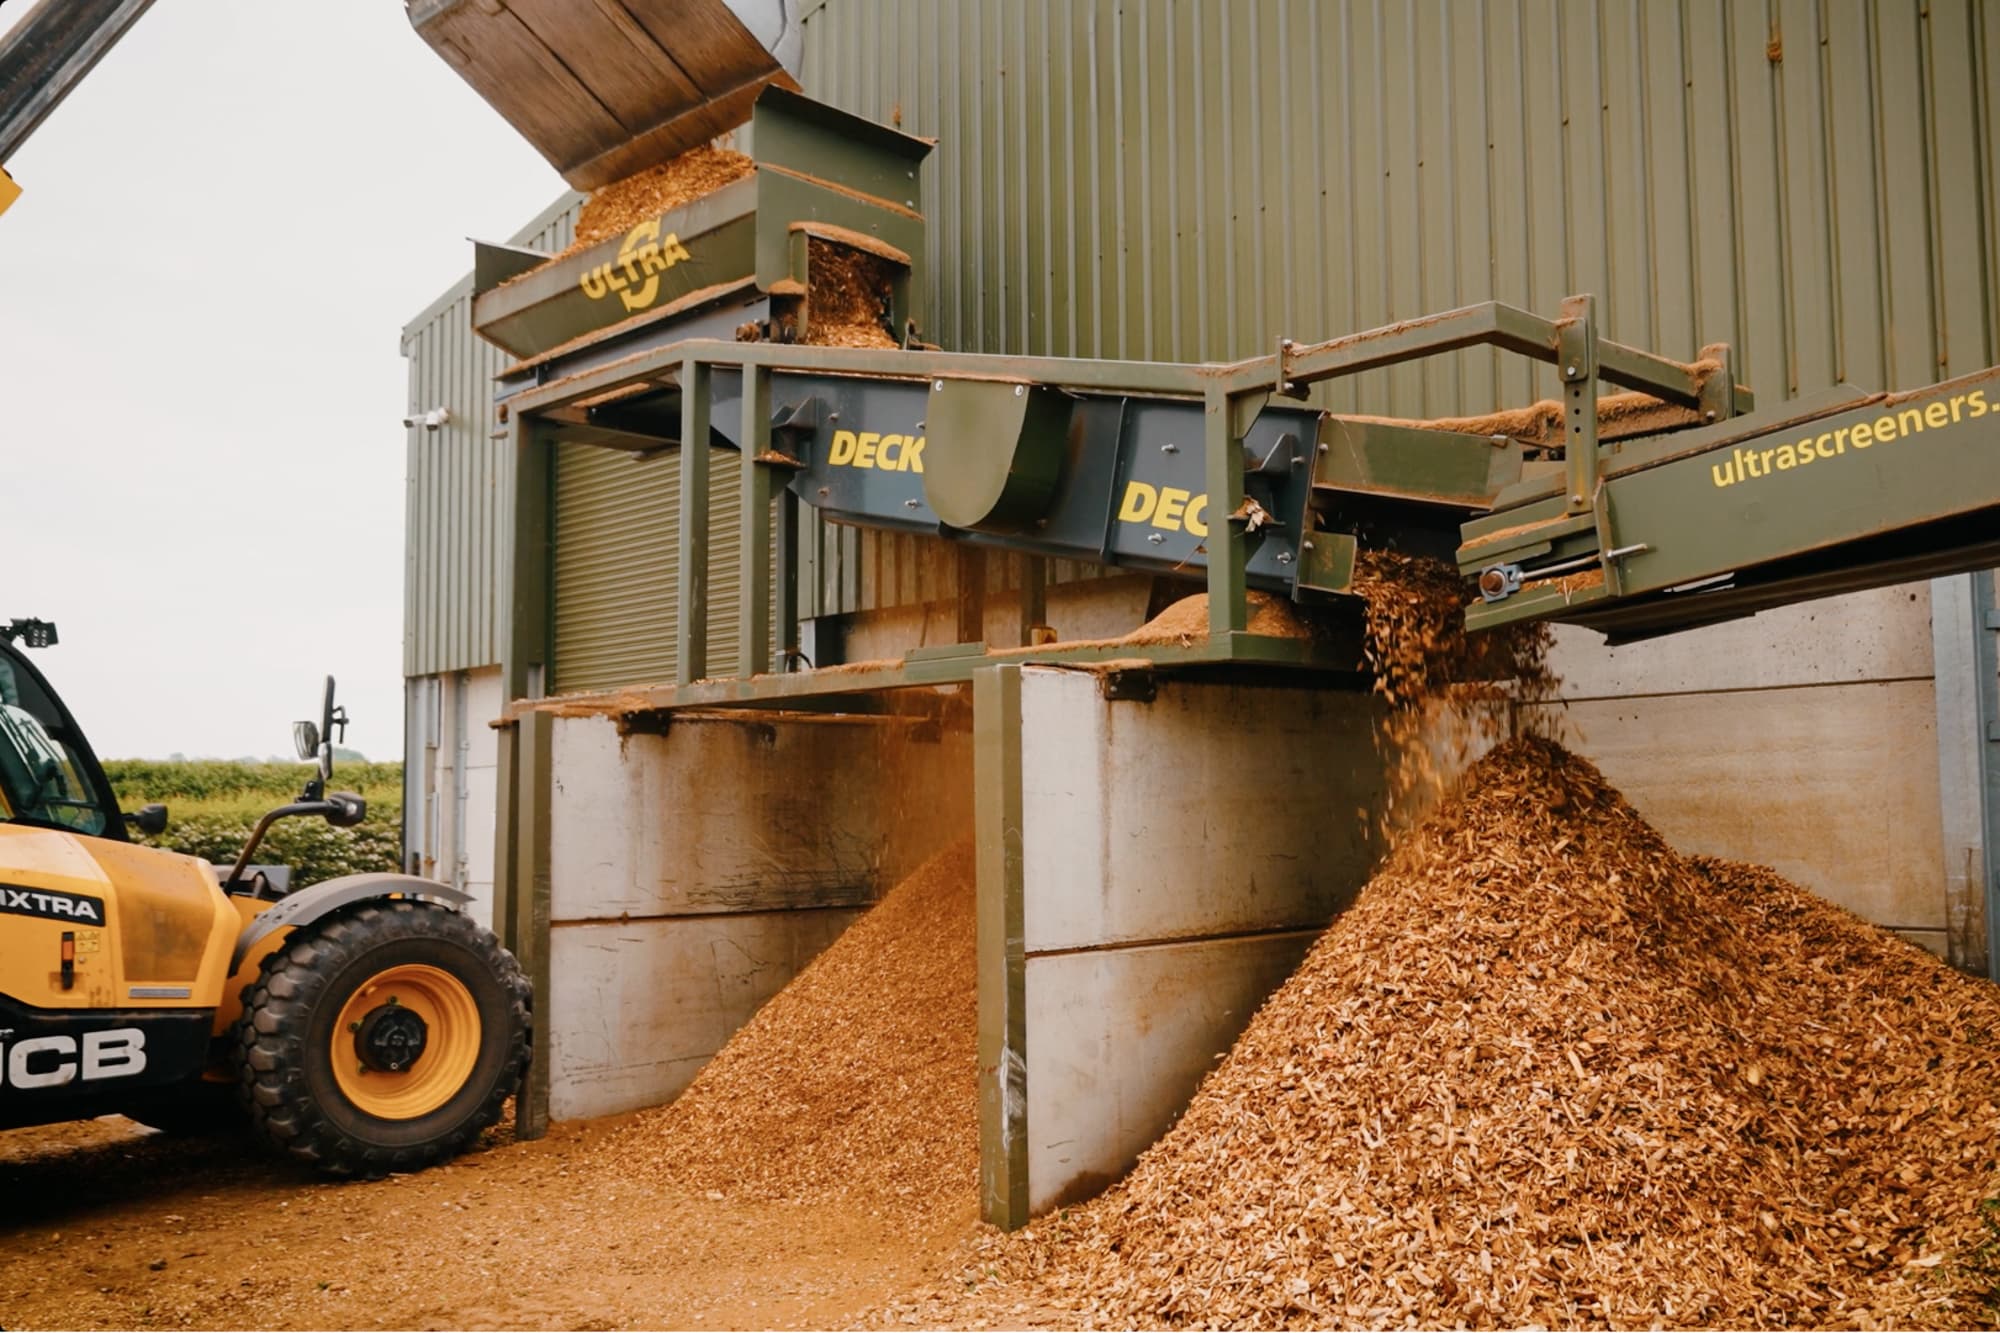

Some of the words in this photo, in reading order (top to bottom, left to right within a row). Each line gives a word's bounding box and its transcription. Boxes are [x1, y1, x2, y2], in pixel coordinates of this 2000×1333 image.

[580, 232, 692, 300] ULTRA
[828, 429, 926, 474] DECK
[1711, 389, 2000, 488] ultrascreeners.
[0, 1027, 147, 1089] CB
